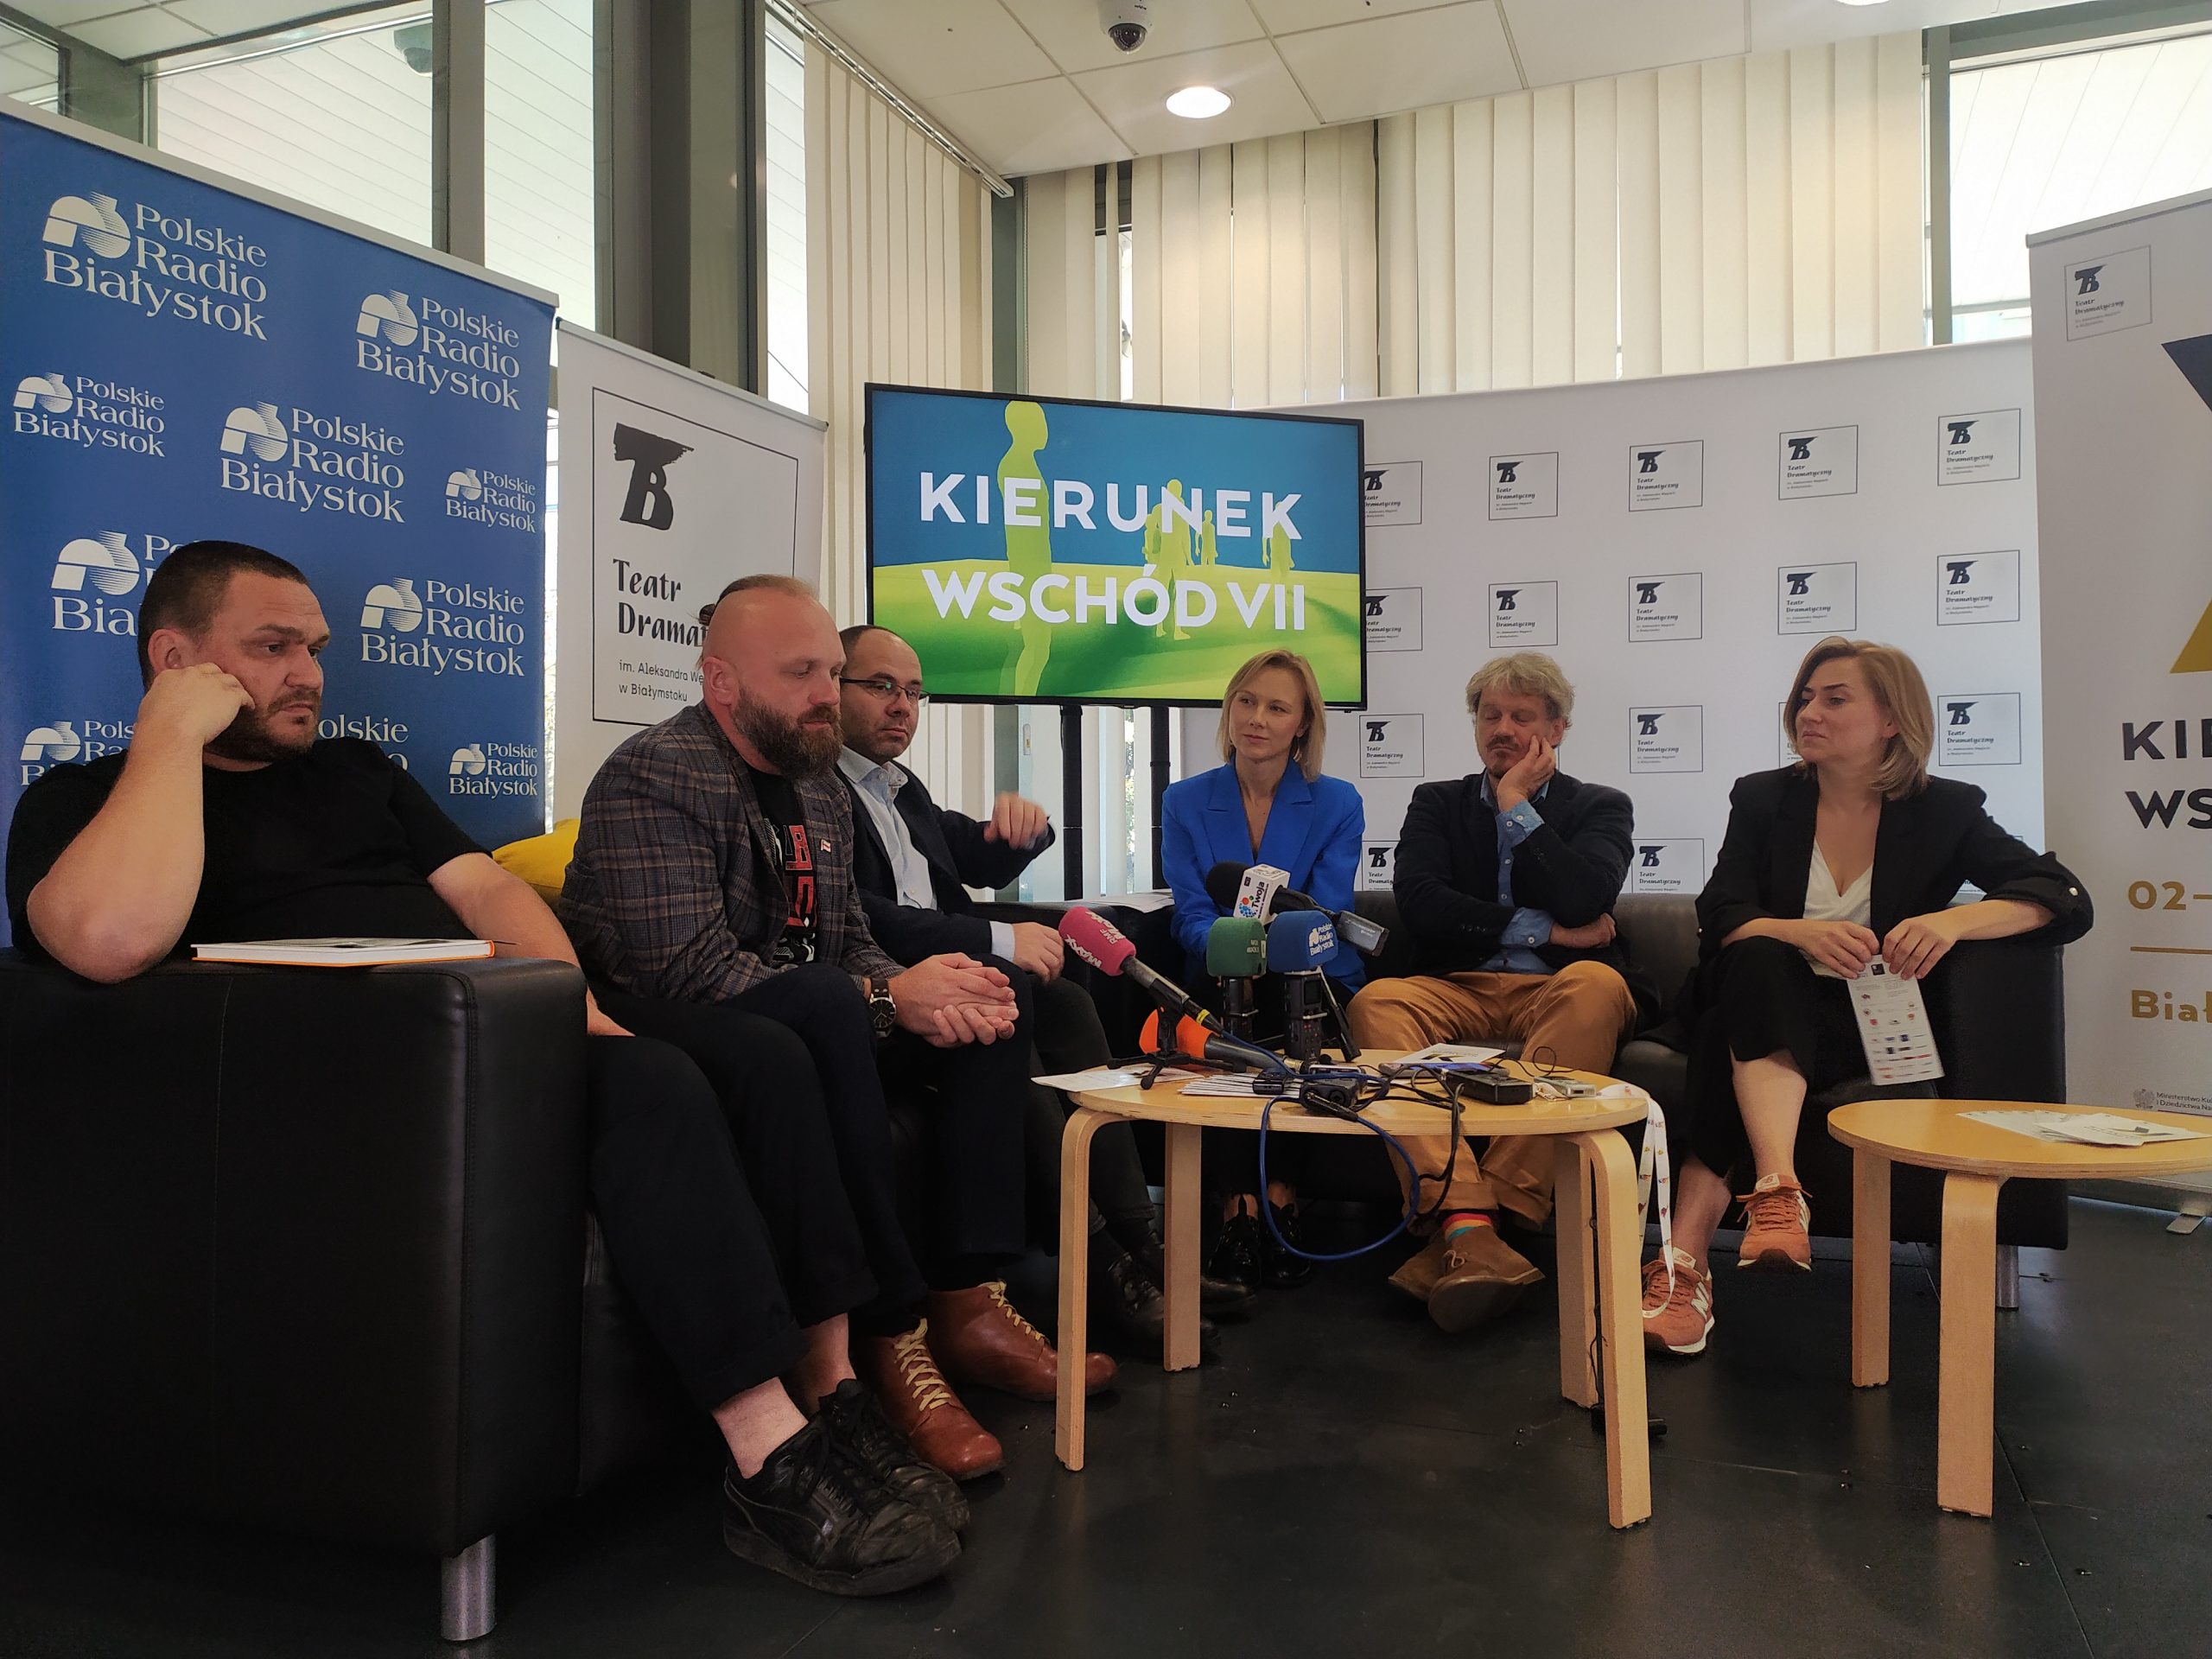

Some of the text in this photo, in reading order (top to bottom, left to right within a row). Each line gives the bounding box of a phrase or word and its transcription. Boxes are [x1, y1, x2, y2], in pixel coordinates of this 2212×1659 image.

[136, 203, 267, 267] Polskie
[136, 236, 267, 302] Radio
[44, 249, 267, 340] Białystok
[422, 297, 518, 347] Polskie
[422, 326, 520, 378] Radio
[357, 340, 521, 410] Białystok
[77, 376, 165, 410] Polskie
[77, 397, 165, 433] Radio
[292, 408, 404, 455] Polskie
[14, 411, 165, 457] Białystok
[292, 438, 404, 489] Radio
[1946, 454, 1994, 463] Dramatyczny
[221, 458, 405, 523] Białystok
[483, 470, 536, 495] Polskie
[484, 486, 536, 514] Radio
[446, 499, 537, 533] Białystok
[920, 472, 1303, 540] KIERUNEK
[426, 580, 524, 614] Polskie
[613, 558, 682, 602] Teatr
[922, 563, 1306, 630] WSCHÓD VII
[52, 596, 137, 637] Bia
[426, 607, 524, 645] Radio
[361, 633, 525, 677] Białystok
[619, 658, 705, 686] im. Aleksandra Wę
[619, 683, 689, 702] w Białymstoku
[84, 720, 135, 740] Pols
[318, 714, 409, 743] olskie
[487, 742, 537, 759] Polskie
[487, 759, 538, 777] Radio
[449, 777, 538, 799] Białystok
[1252, 881, 1265, 908] Twoja
[1099, 928, 1117, 944] RMF
[2157, 1091, 2200, 1103] Ministerstwo
[2160, 1099, 2200, 1110] Dziedzictwa
